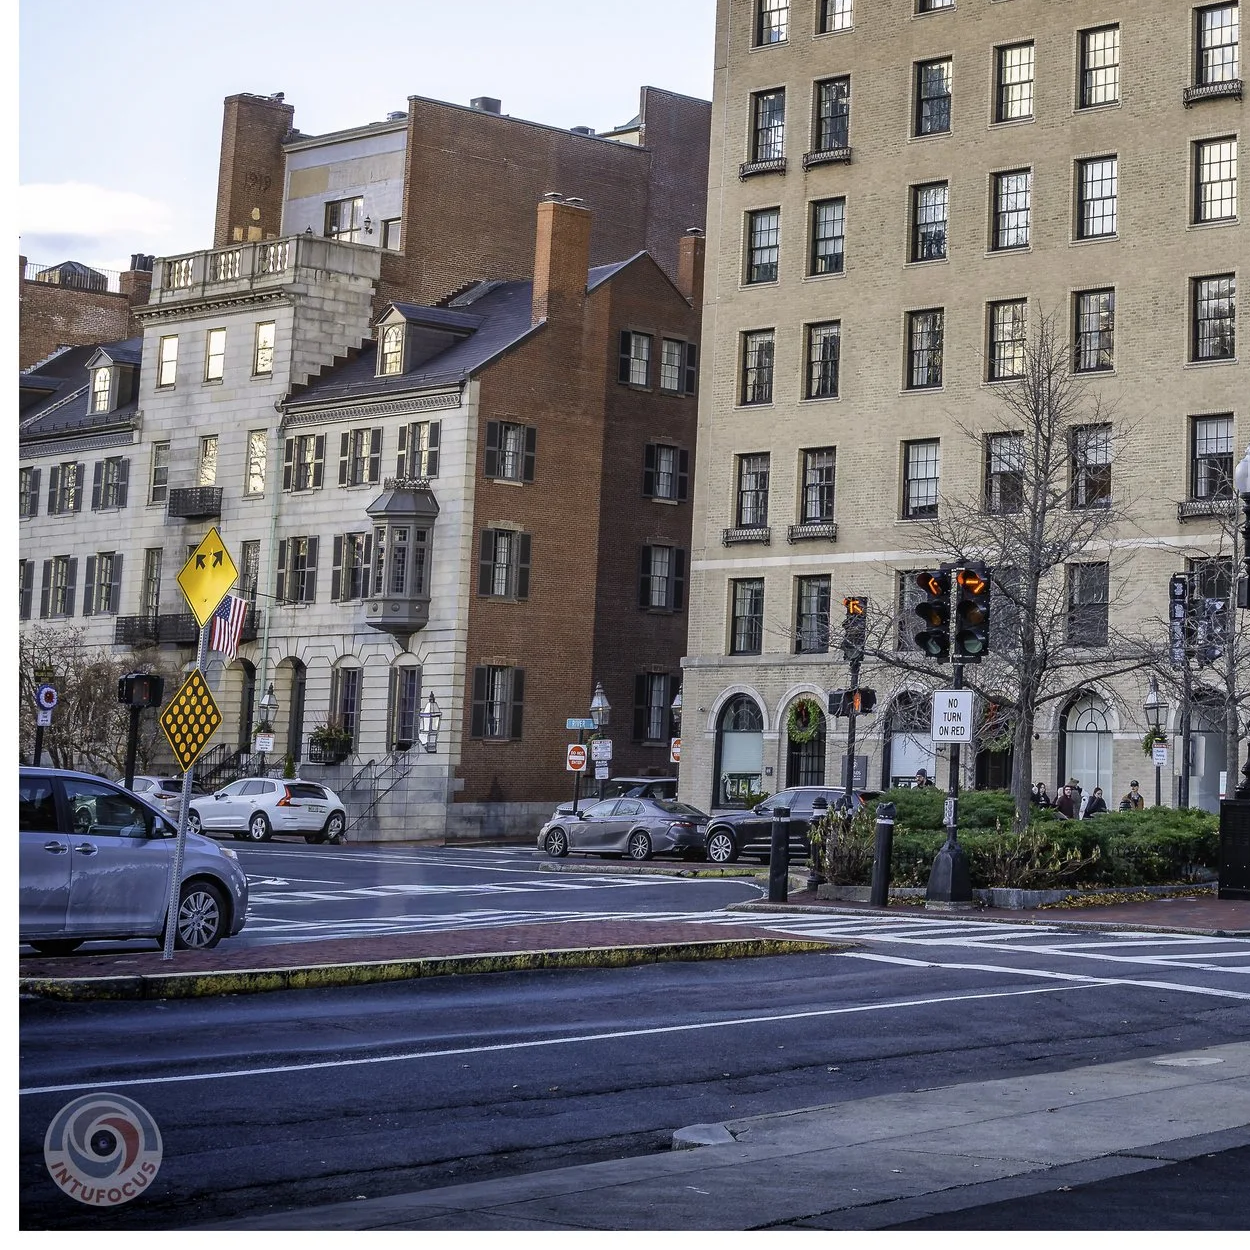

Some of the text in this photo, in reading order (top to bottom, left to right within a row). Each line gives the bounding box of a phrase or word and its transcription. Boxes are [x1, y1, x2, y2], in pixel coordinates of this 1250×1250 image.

[948, 698, 958, 708] NO
[943, 712, 962, 722] TURN
[939, 726, 965, 736] ON RED
